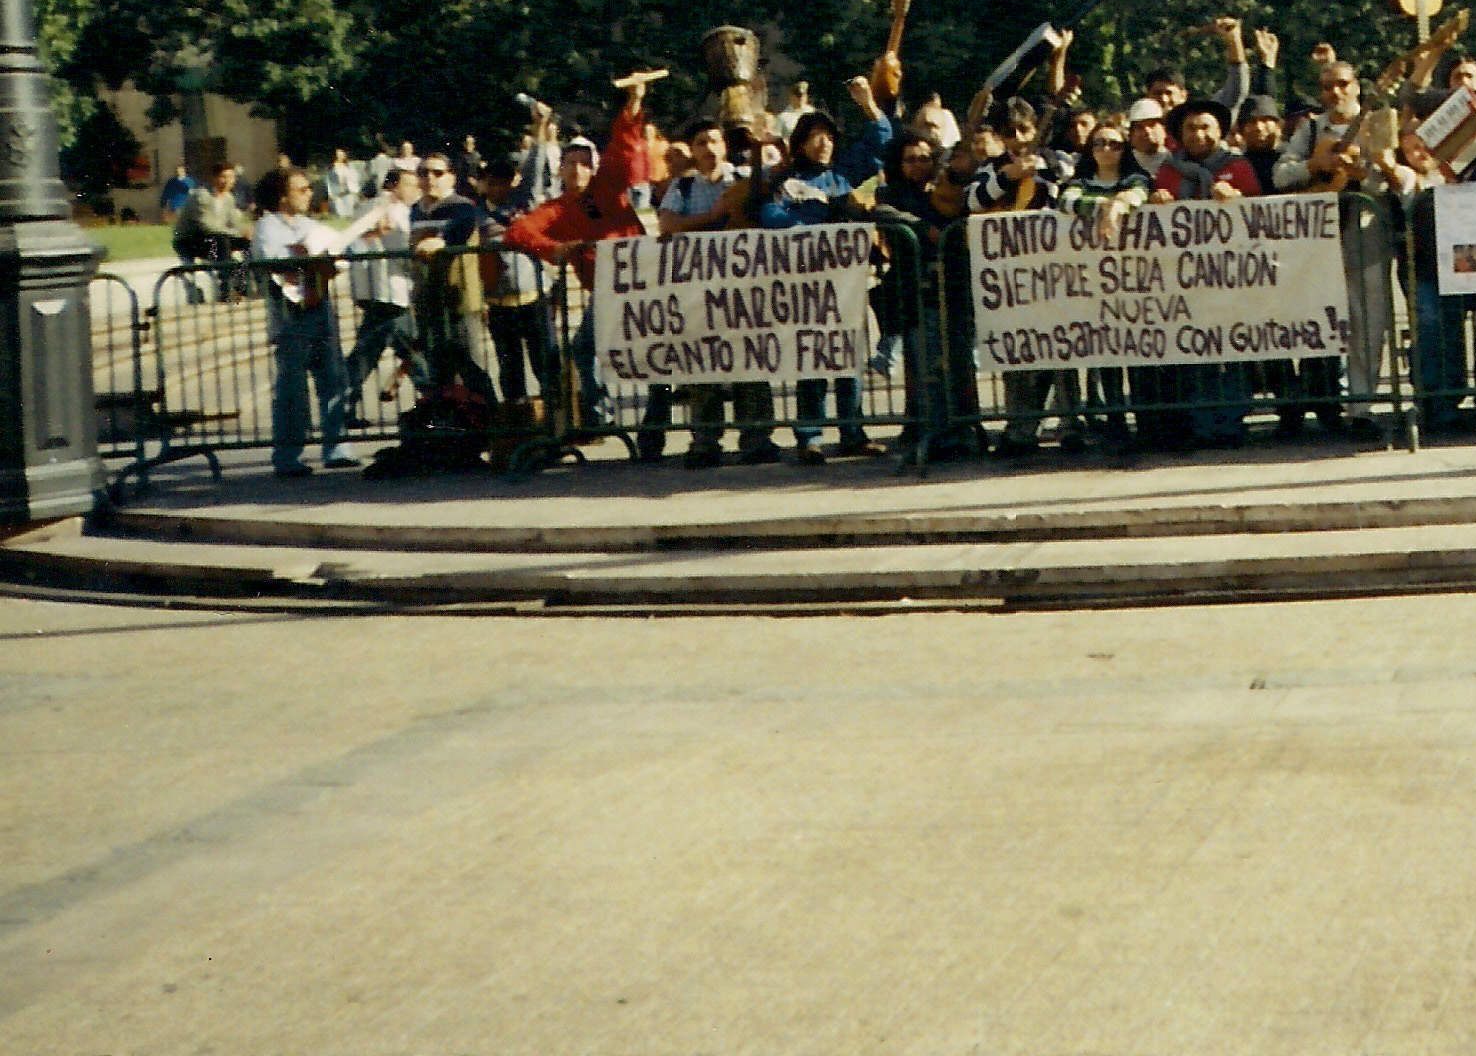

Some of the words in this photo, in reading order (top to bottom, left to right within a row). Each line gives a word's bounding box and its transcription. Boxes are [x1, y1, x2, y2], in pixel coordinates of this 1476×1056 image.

[981, 214, 1057, 261] CANTO
[1118, 210, 1167, 252] HA
[1171, 205, 1233, 249] SIDO
[612, 241, 646, 295] EL
[980, 262, 1093, 311] SIEMPRE
[622, 294, 685, 341] NOS
[704, 279, 842, 330] MARGINA
[1101, 294, 1192, 324] NUEVA
[609, 345, 649, 381] EL
[647, 335, 734, 376] CANTO
[745, 331, 781, 374] NO
